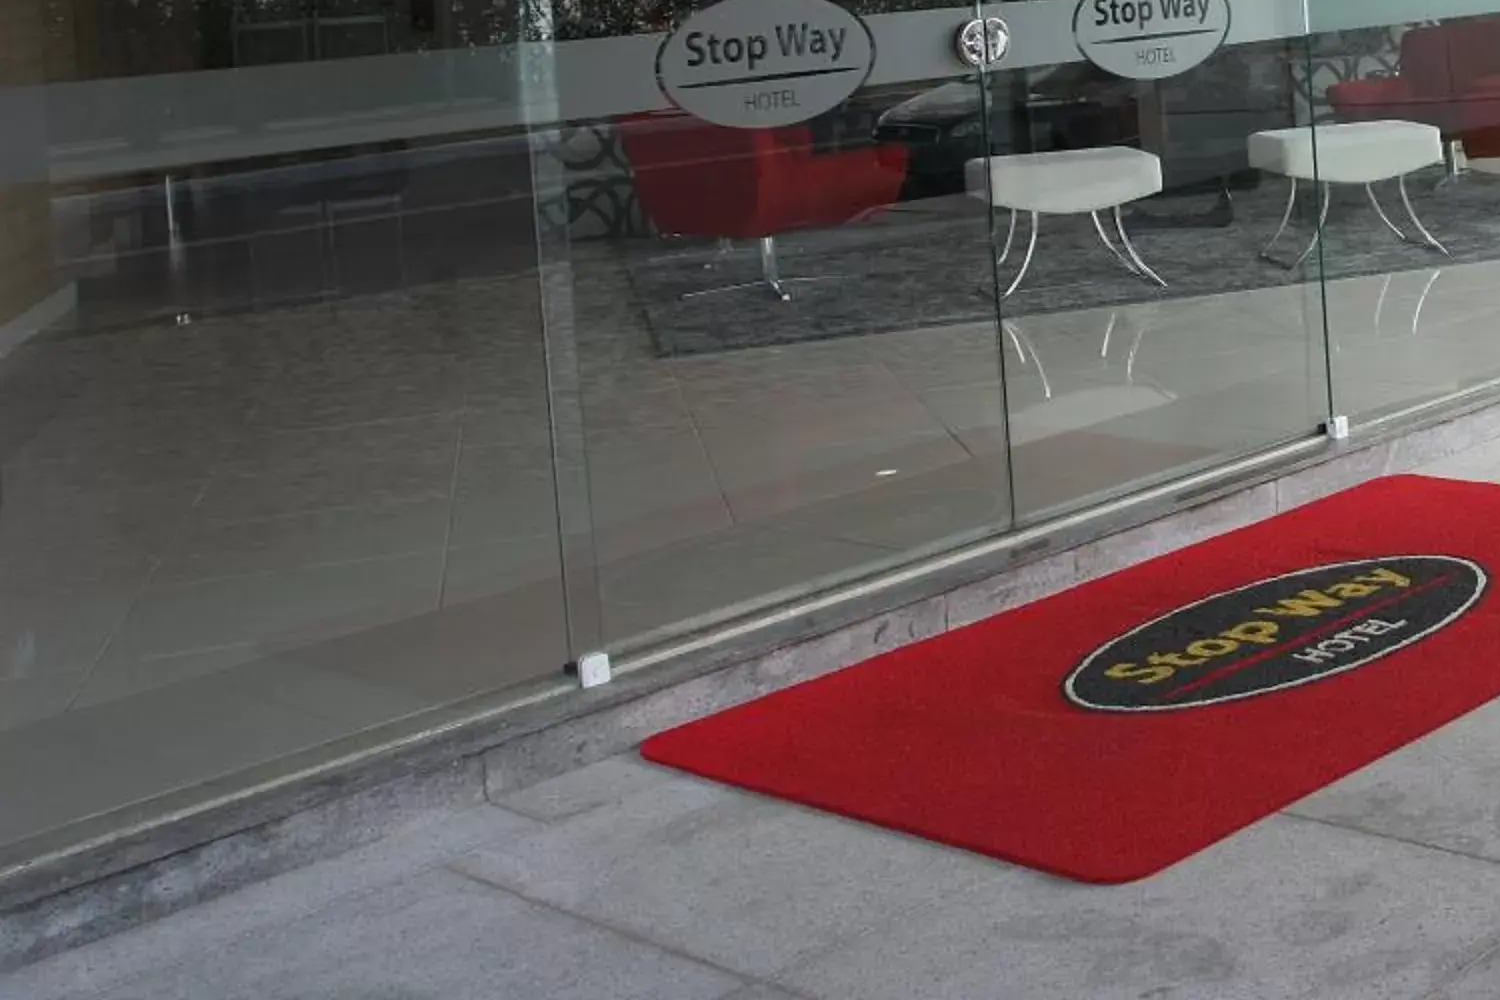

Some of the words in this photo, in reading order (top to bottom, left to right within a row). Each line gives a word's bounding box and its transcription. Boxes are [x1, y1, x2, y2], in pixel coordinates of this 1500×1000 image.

[685, 31, 768, 70] Stop
[775, 22, 847, 62] Way
[1136, 46, 1176, 65] HOTEL
[743, 89, 801, 112] HOTEL
[1103, 620, 1280, 685] Stop
[1252, 568, 1412, 618] Way
[1294, 617, 1408, 665] HOTEL
